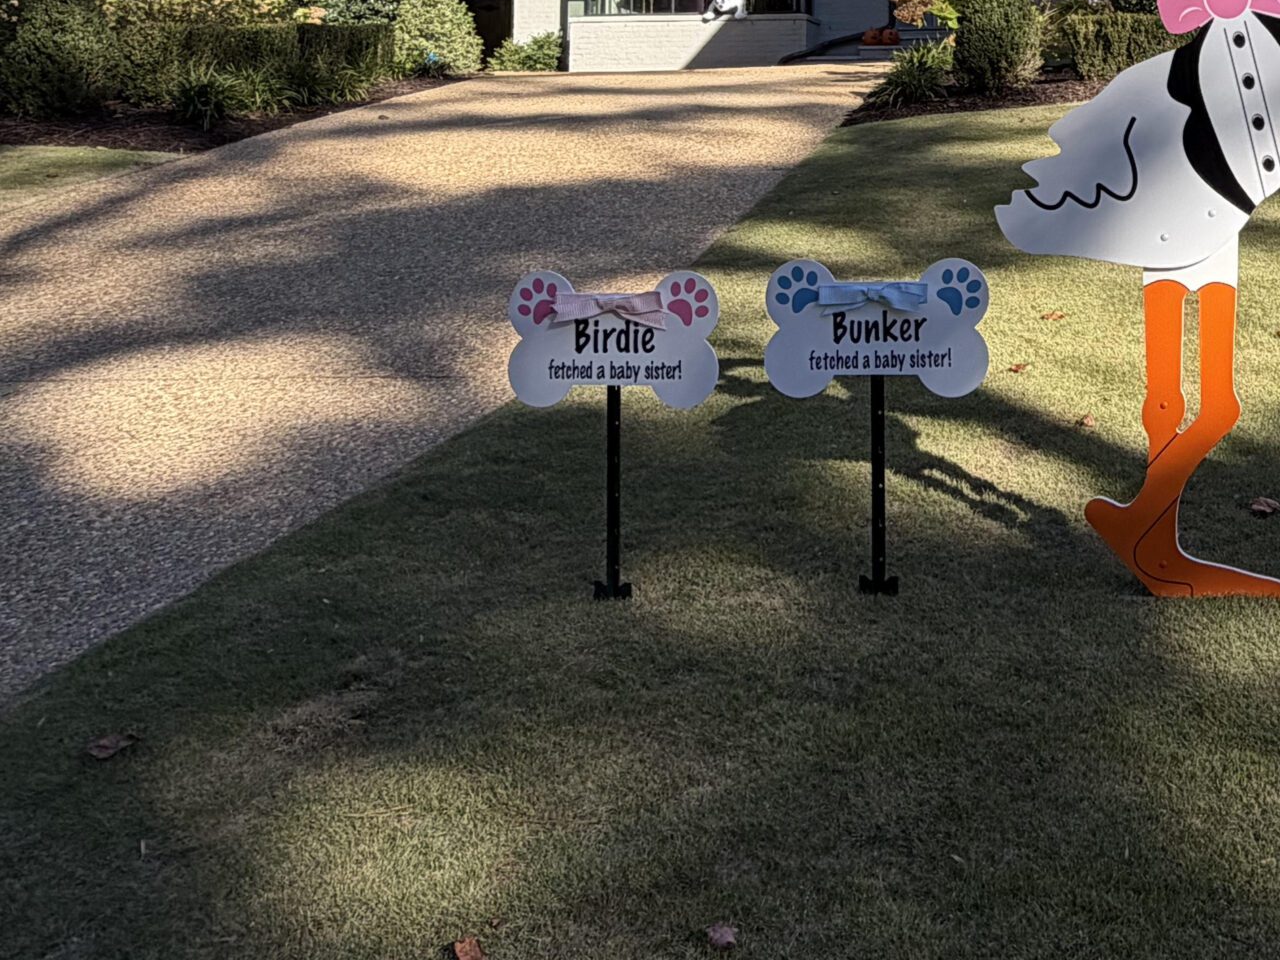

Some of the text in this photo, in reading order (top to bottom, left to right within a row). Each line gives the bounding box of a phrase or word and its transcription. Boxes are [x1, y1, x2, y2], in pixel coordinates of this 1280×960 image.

[574, 319, 656, 354] Birdie
[832, 311, 927, 343] Bunker
[548, 359, 682, 385] fetched a baby sister!
[808, 350, 952, 374] fetched a baby sister!
